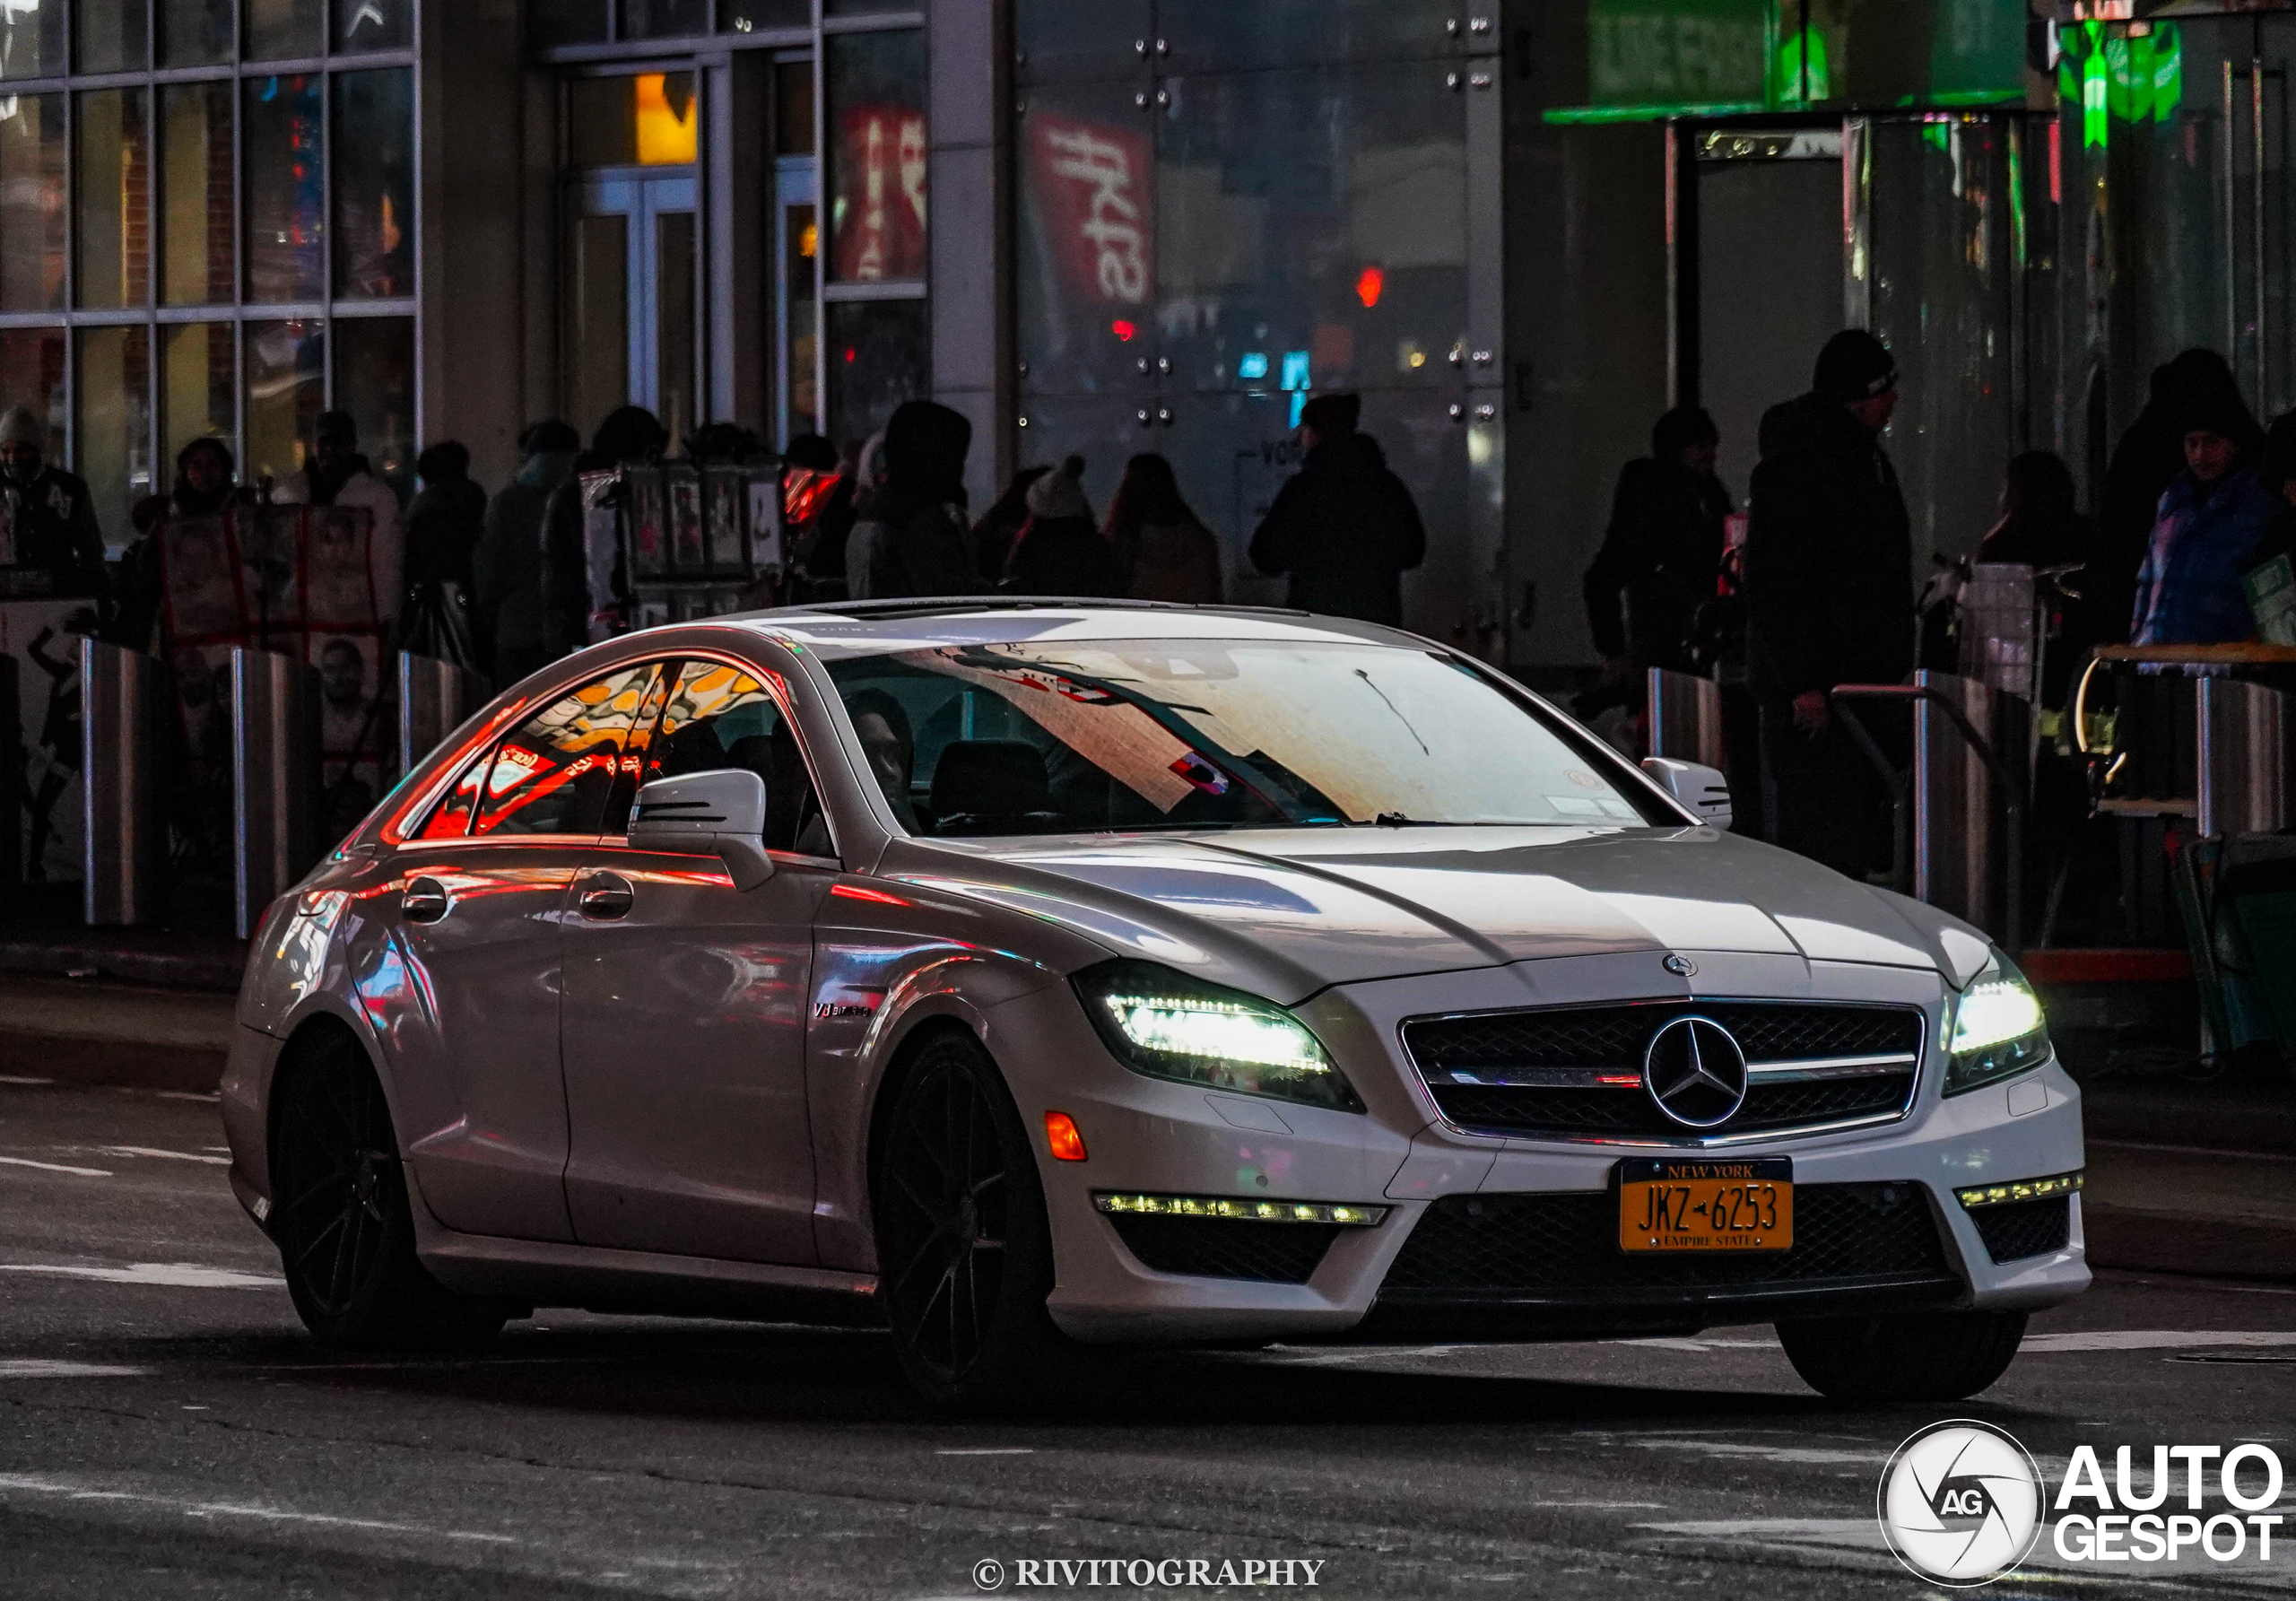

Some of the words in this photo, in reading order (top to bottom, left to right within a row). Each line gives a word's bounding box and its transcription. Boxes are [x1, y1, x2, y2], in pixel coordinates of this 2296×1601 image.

[1668, 1166, 1709, 1179] NEW
[1713, 1165, 1753, 1179] YORK
[1664, 1235, 1709, 1247] EMPIRE
[1716, 1235, 1752, 1247] STATE
